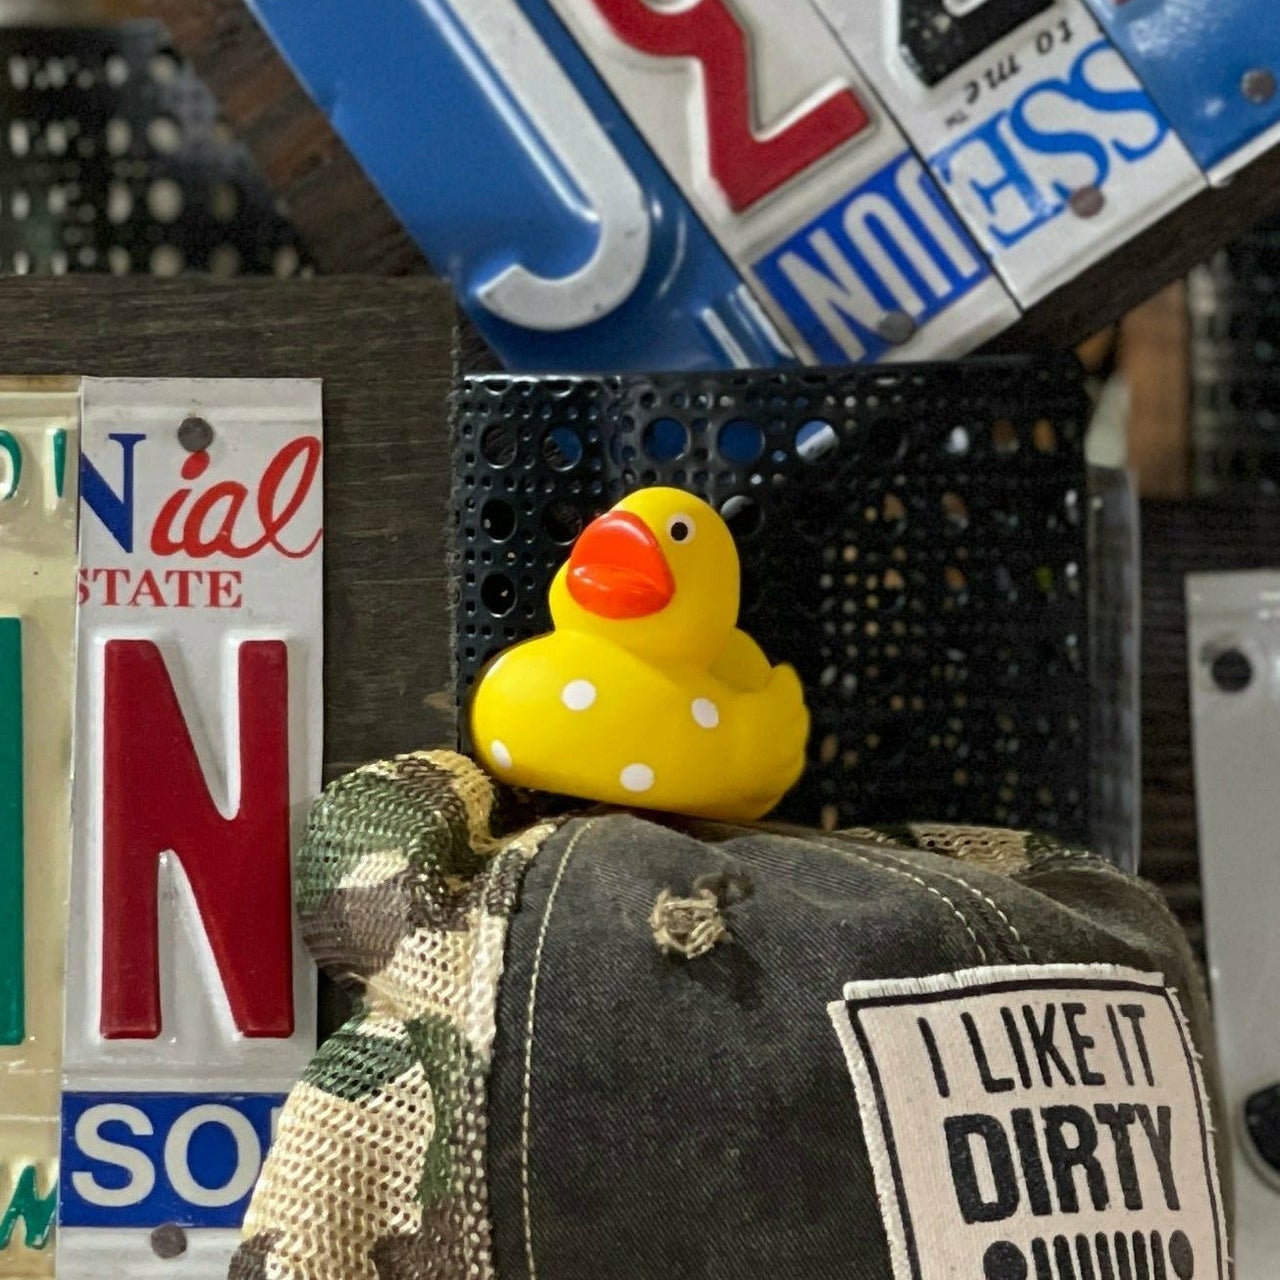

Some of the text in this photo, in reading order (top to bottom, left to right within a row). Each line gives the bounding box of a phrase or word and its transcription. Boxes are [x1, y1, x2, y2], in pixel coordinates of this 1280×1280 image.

[78, 568, 243, 609] STATE
[917, 1002, 1156, 1098] I LIKE IT
[71, 1102, 284, 1208] SO
[943, 1103, 1181, 1225] DIRTY
